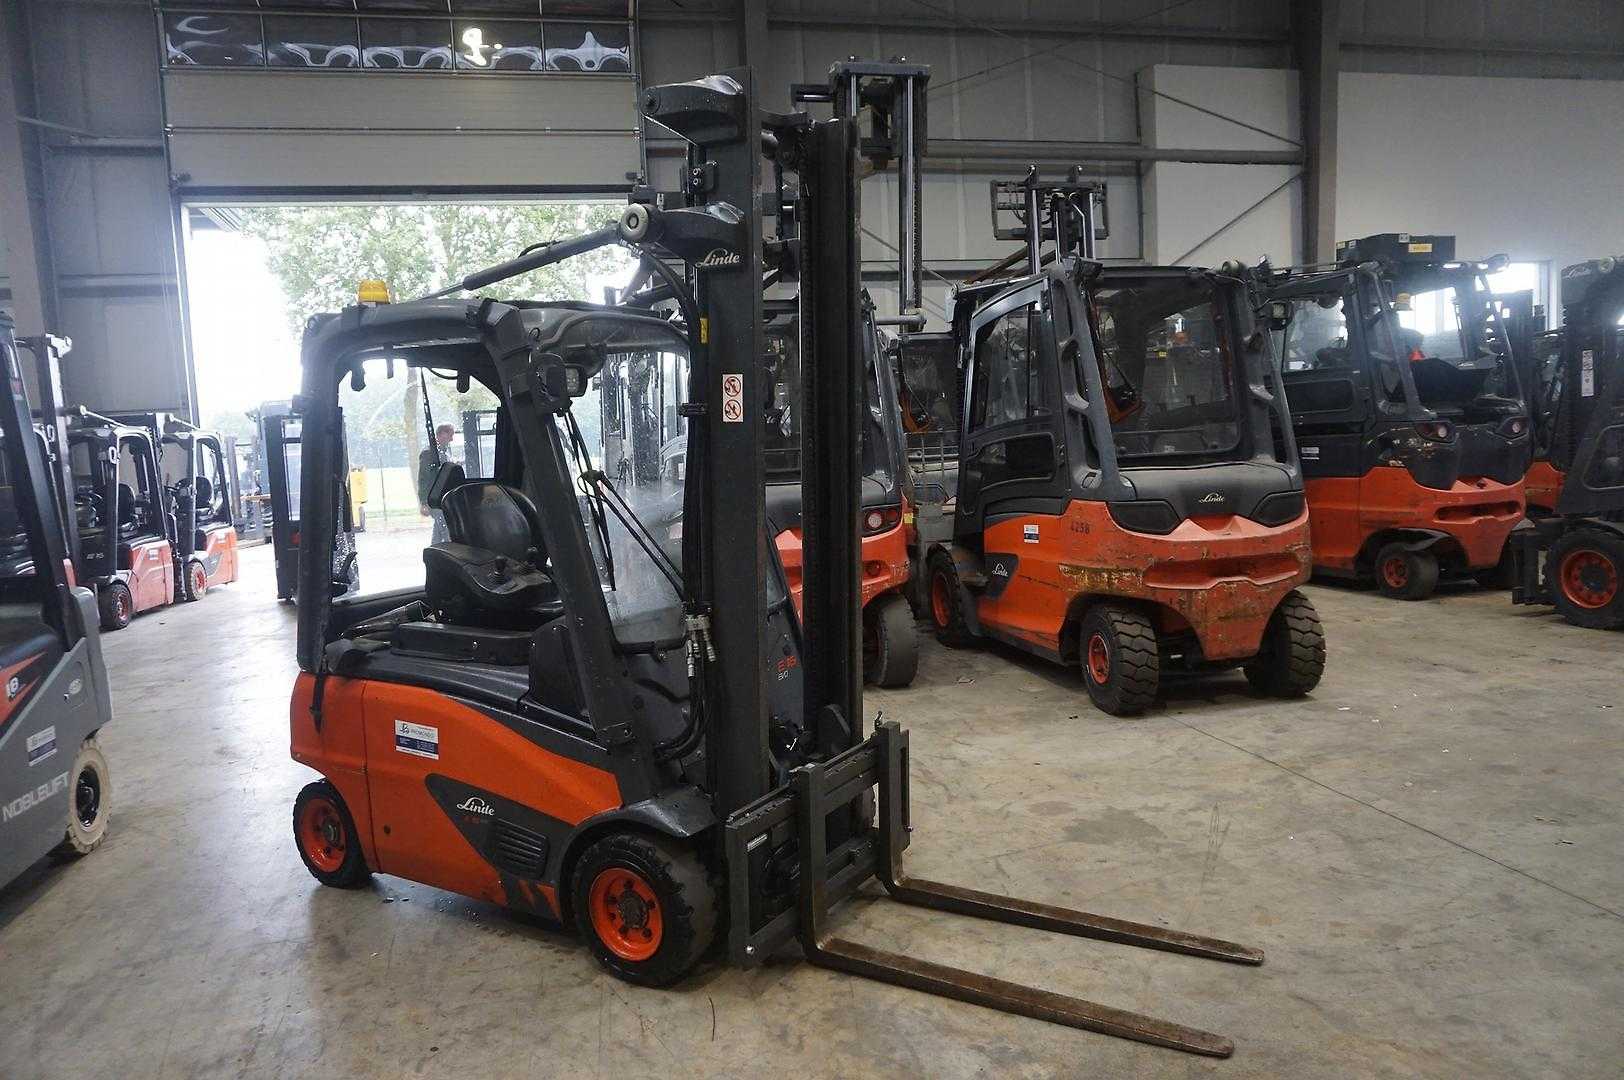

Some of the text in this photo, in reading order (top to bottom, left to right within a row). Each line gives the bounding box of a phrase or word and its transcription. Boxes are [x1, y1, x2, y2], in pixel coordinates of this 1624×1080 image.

[695, 248, 740, 267] Linde
[1198, 492, 1225, 504] Linde
[2, 771, 70, 823] NOBLELIFT
[456, 796, 495, 816] Linde
